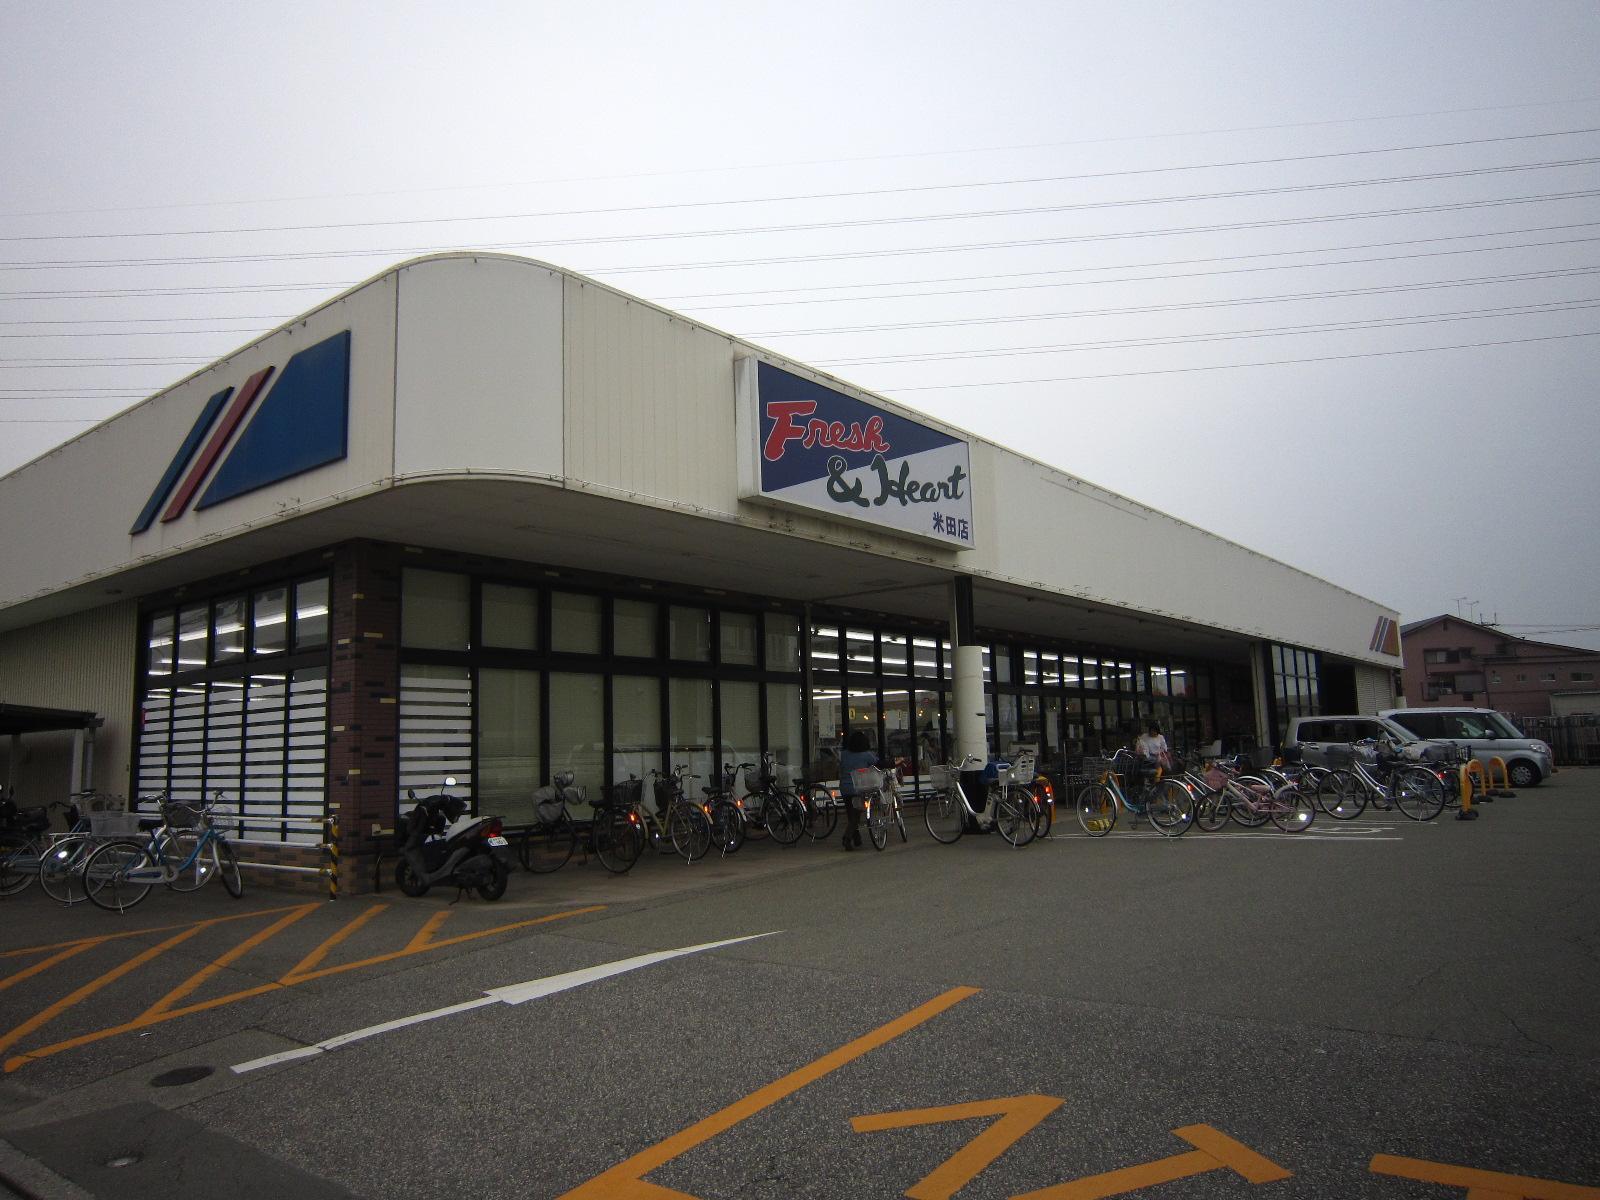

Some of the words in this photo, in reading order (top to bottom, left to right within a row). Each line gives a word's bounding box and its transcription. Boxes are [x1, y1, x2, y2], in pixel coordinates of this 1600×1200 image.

[764, 400, 890, 461] Fresh
[827, 455, 870, 507] &
[871, 454, 966, 506] Heart
[933, 511, 969, 540] 米田店
